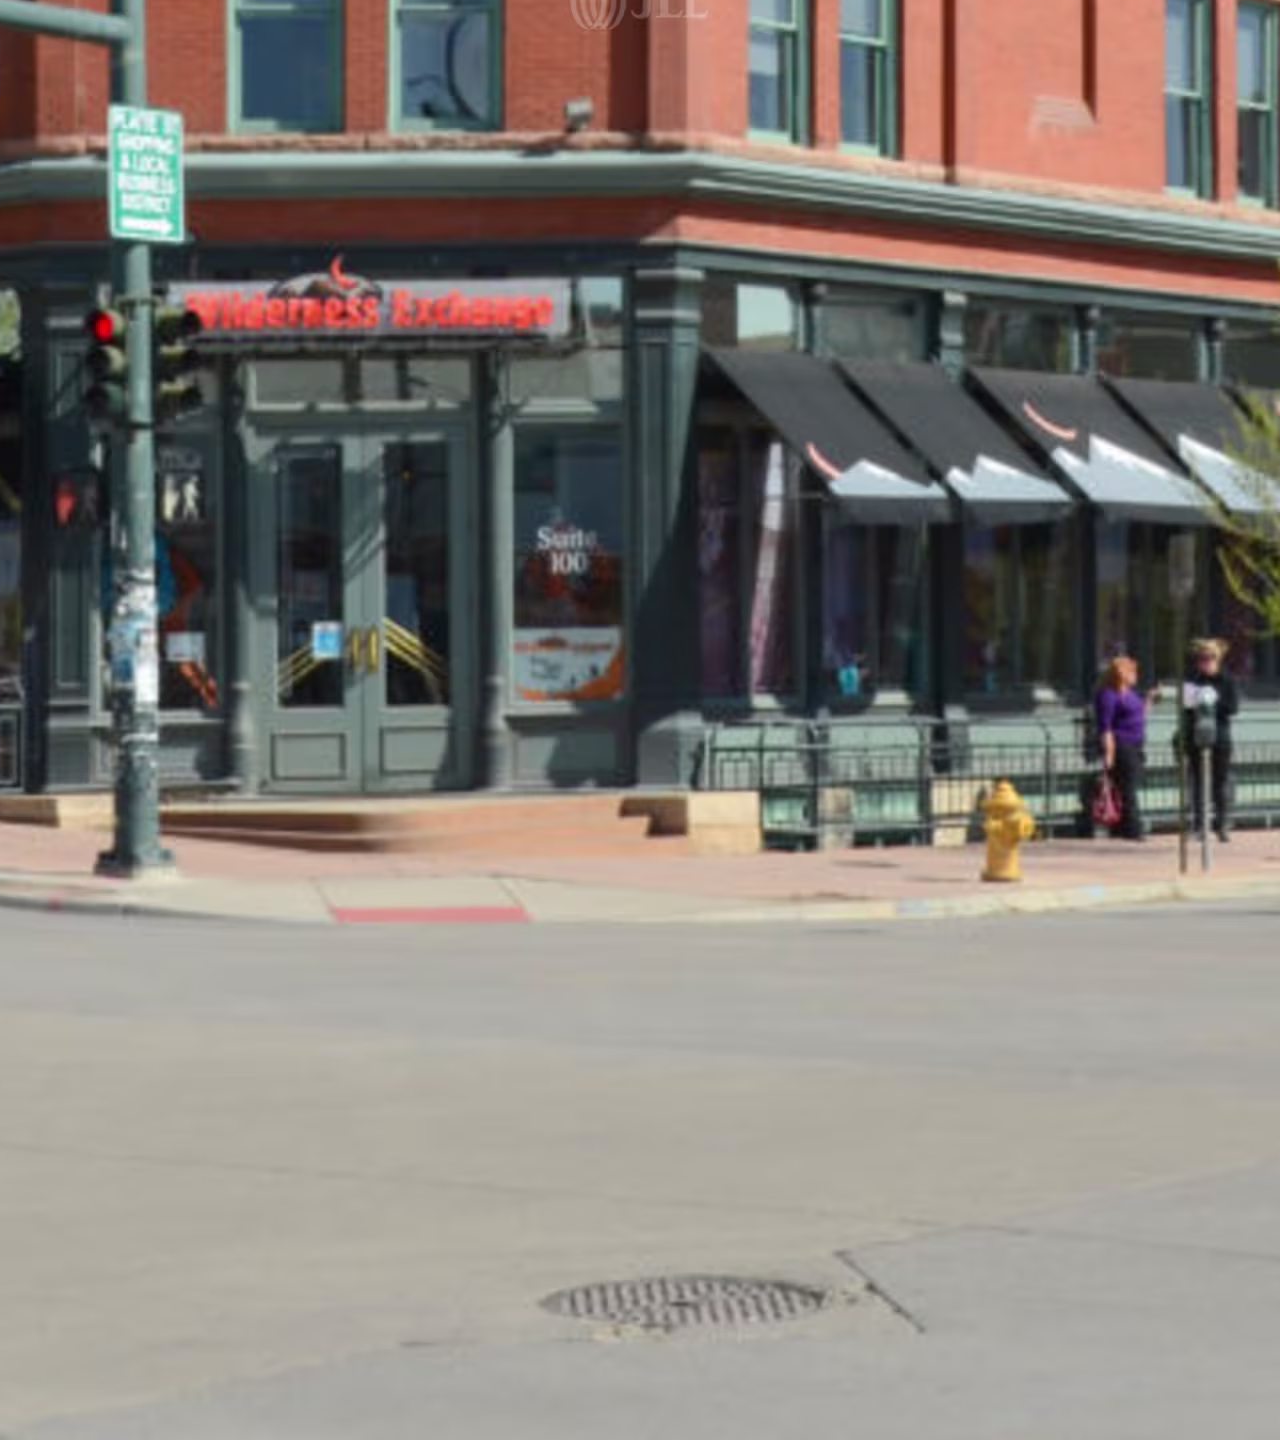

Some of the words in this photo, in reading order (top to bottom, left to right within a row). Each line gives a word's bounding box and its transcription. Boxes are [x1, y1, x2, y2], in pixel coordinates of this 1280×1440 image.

[118, 172, 175, 195] BUSINESS
[185, 291, 379, 330] Wilderness
[391, 289, 554, 330] Exchange
[551, 551, 588, 575] 100
